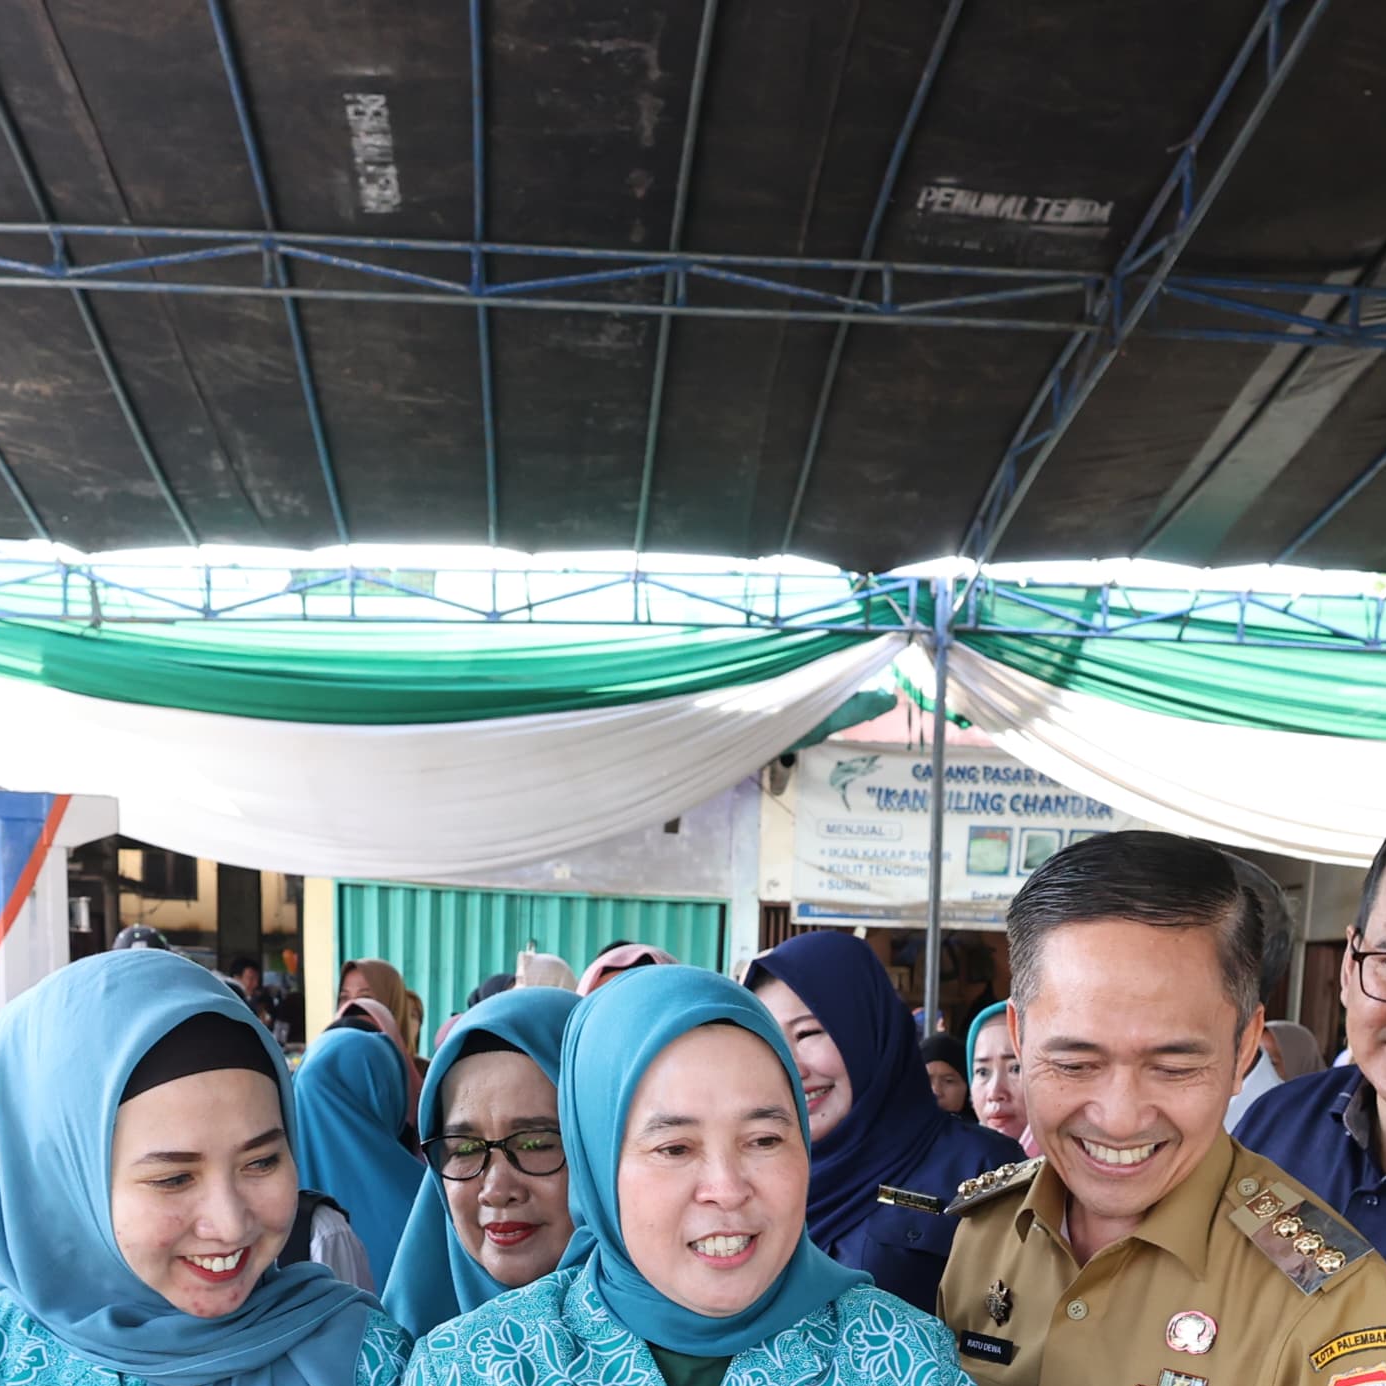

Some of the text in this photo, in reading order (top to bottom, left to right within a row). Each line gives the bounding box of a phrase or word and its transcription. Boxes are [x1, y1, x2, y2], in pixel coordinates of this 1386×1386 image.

[912, 763, 980, 783] CAANG
[983, 766, 1035, 786] PASAR
[944, 789, 1004, 815] ILING
[828, 848, 859, 860] IKAN
[863, 849, 907, 861] KAKAP
[827, 864, 863, 875] KULIT
[967, 1338, 1001, 1354] RATU DEWA
[1314, 1347, 1336, 1366] KOTA
